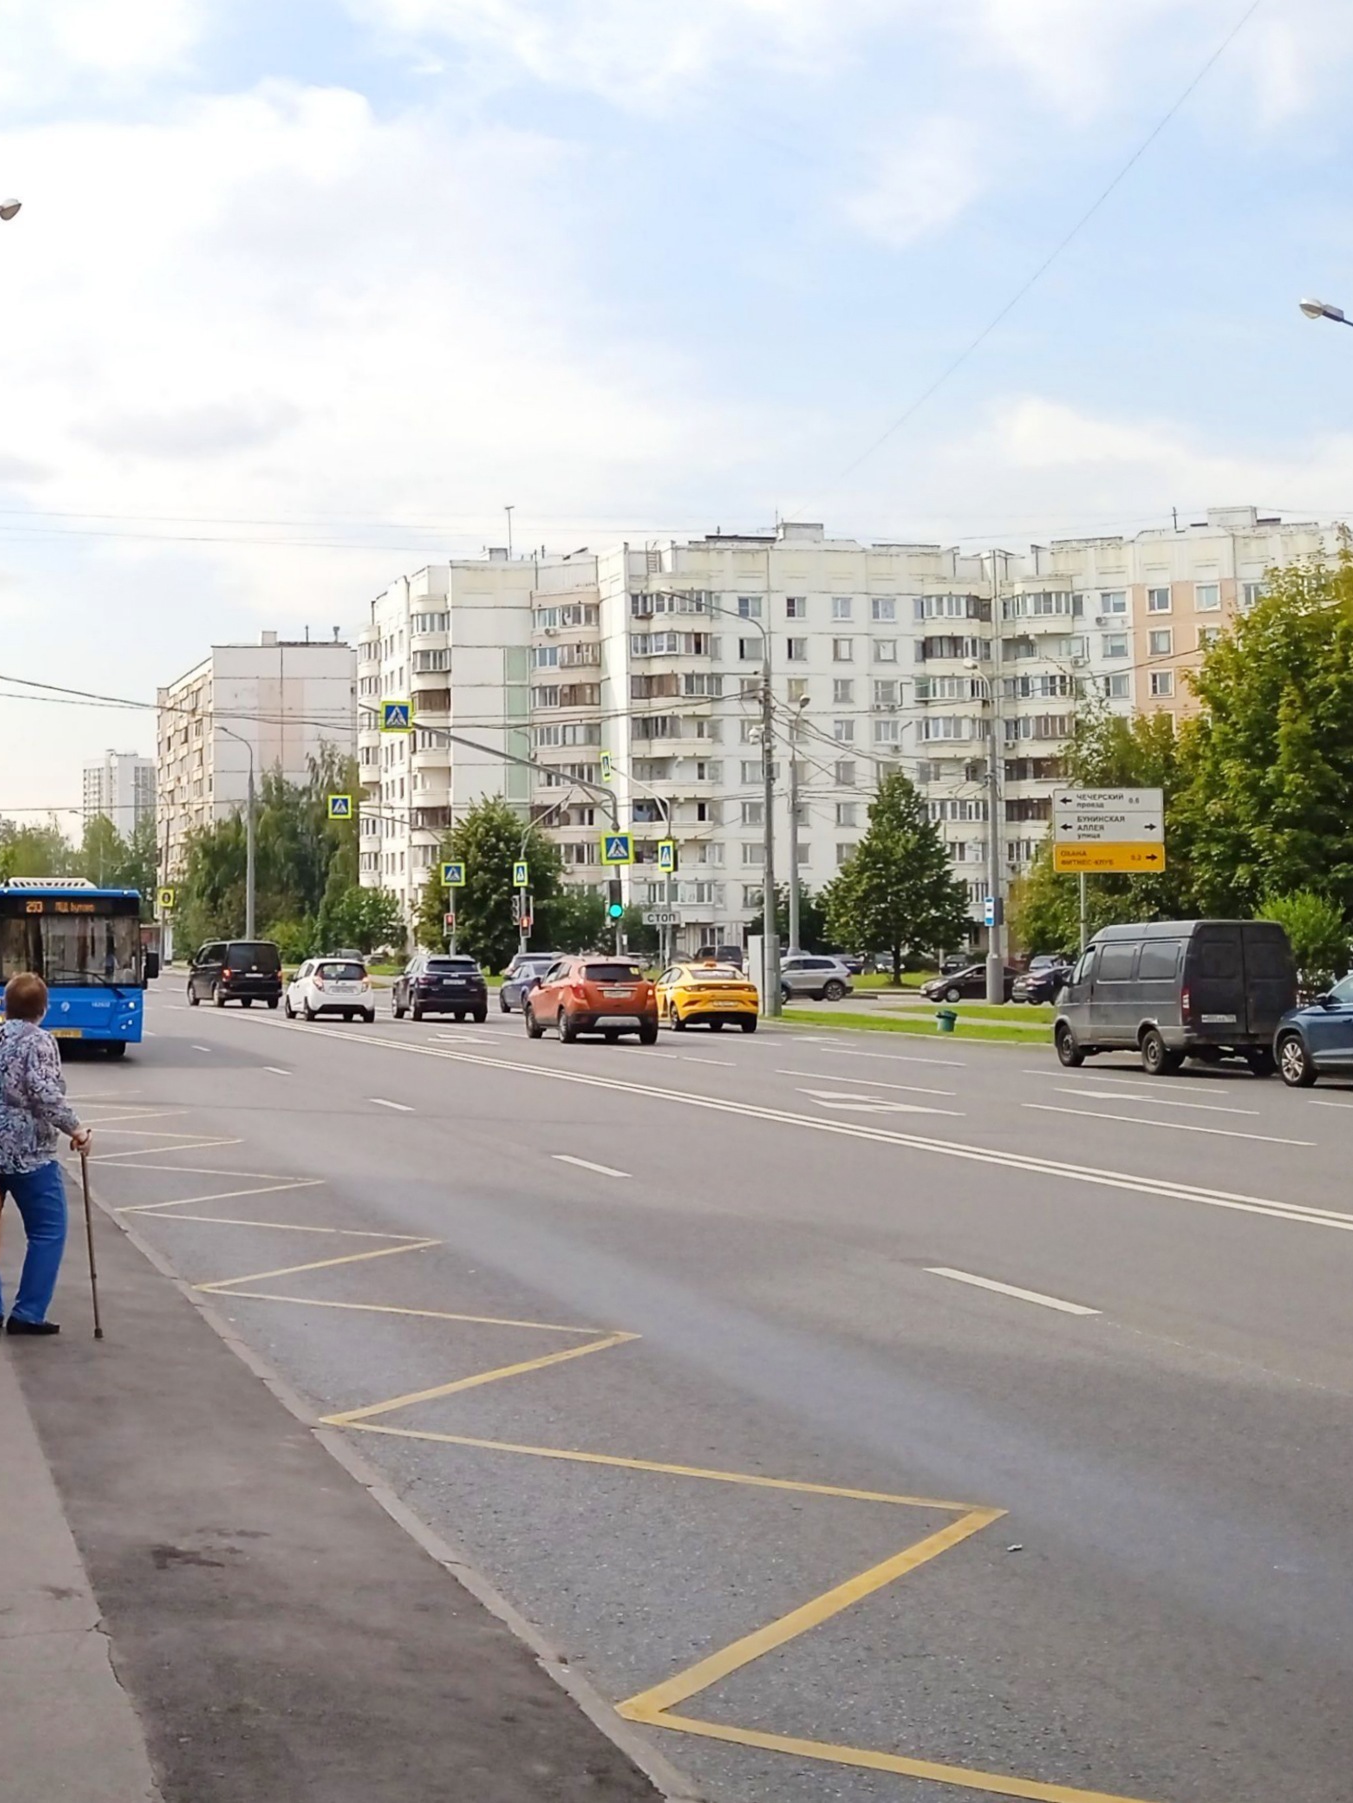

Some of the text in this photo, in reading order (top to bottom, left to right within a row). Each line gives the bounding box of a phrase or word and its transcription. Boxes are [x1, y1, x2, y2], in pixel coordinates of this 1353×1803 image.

[1076, 815, 1126, 824] БУНИНСКАЯ
[1076, 824, 1105, 832] АЛЛЕЯ
[647, 913, 676, 923] СТОП
